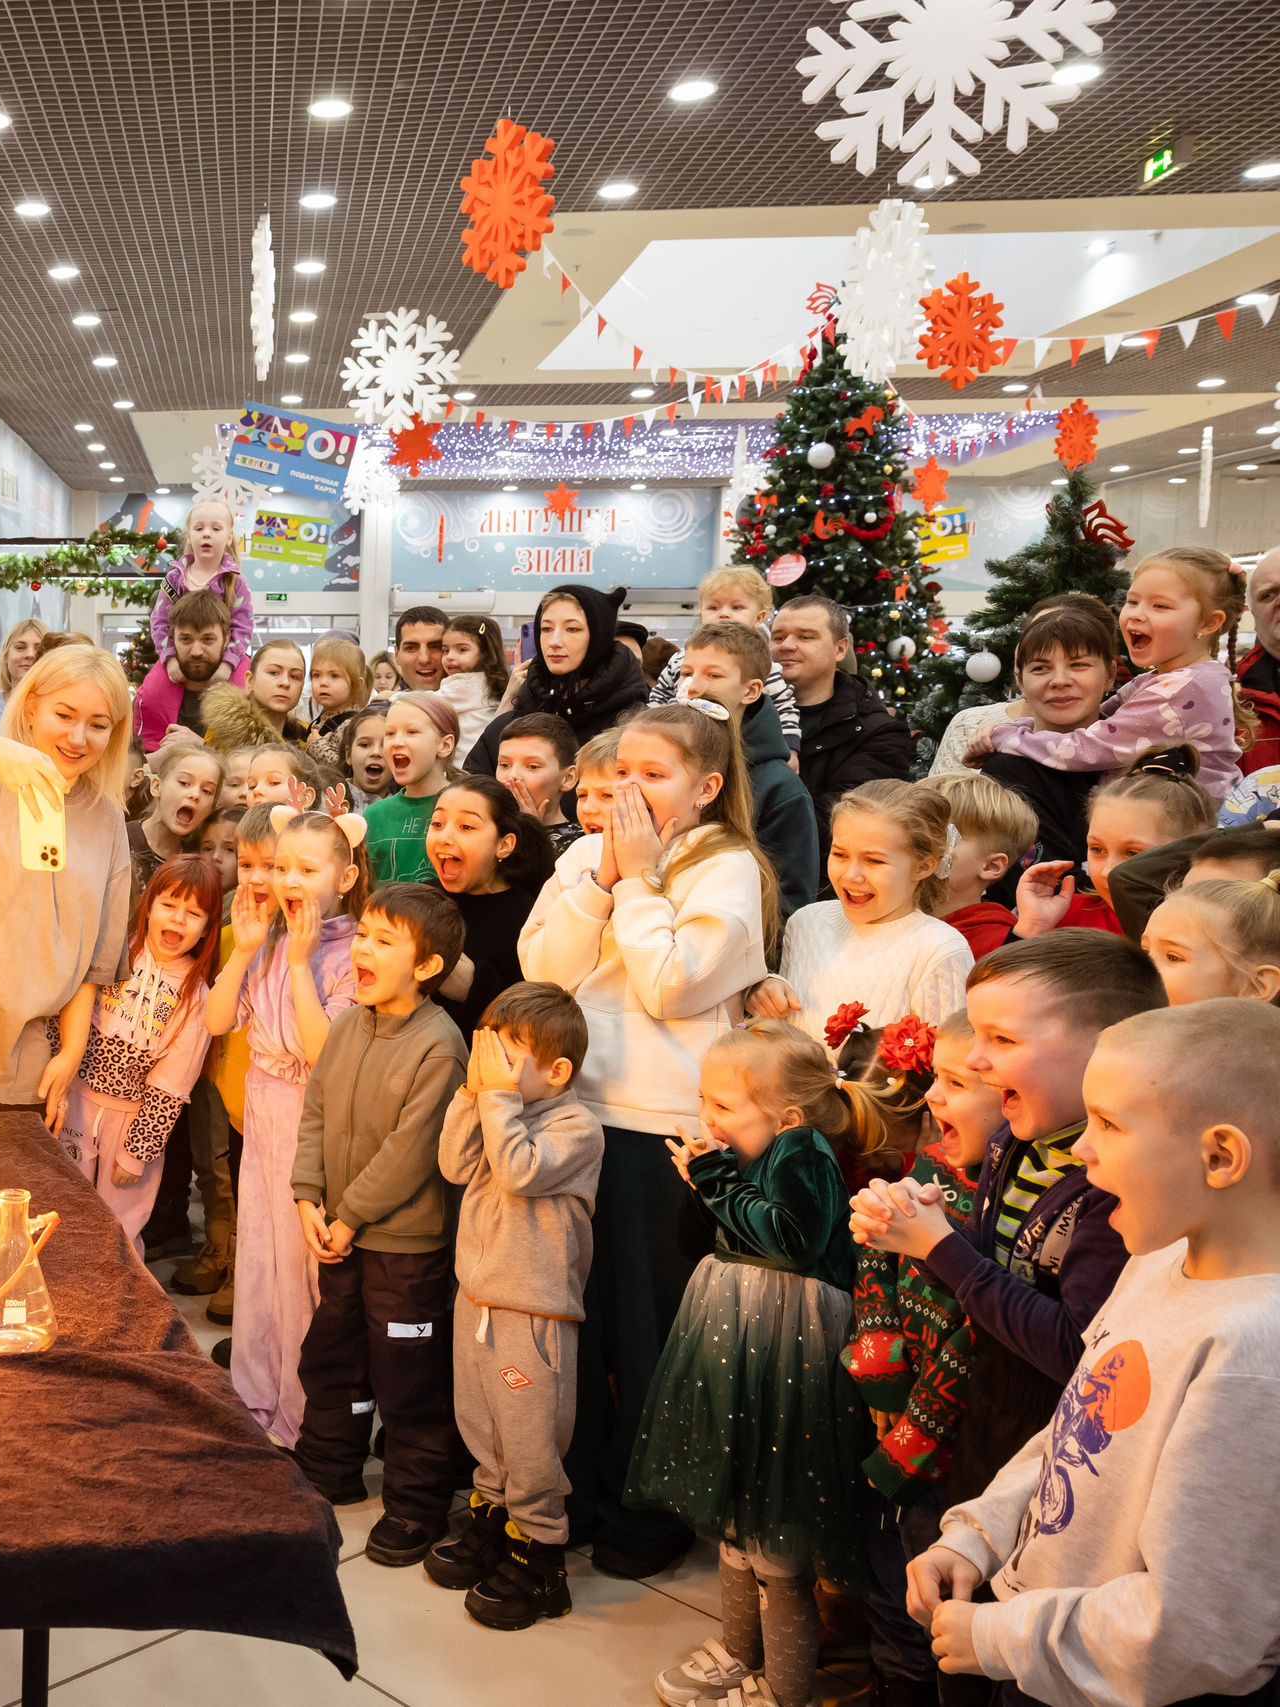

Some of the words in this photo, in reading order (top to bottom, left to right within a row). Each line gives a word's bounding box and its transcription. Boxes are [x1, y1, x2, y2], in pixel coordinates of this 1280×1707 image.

[290, 469, 340, 488] ПОДАРОЧНАЯ
[314, 483, 337, 495] КАРТА
[513, 547, 593, 574] ЗИМА
[140, 1019, 162, 1038] NED
[5, 1299, 26, 1307] 500ml
